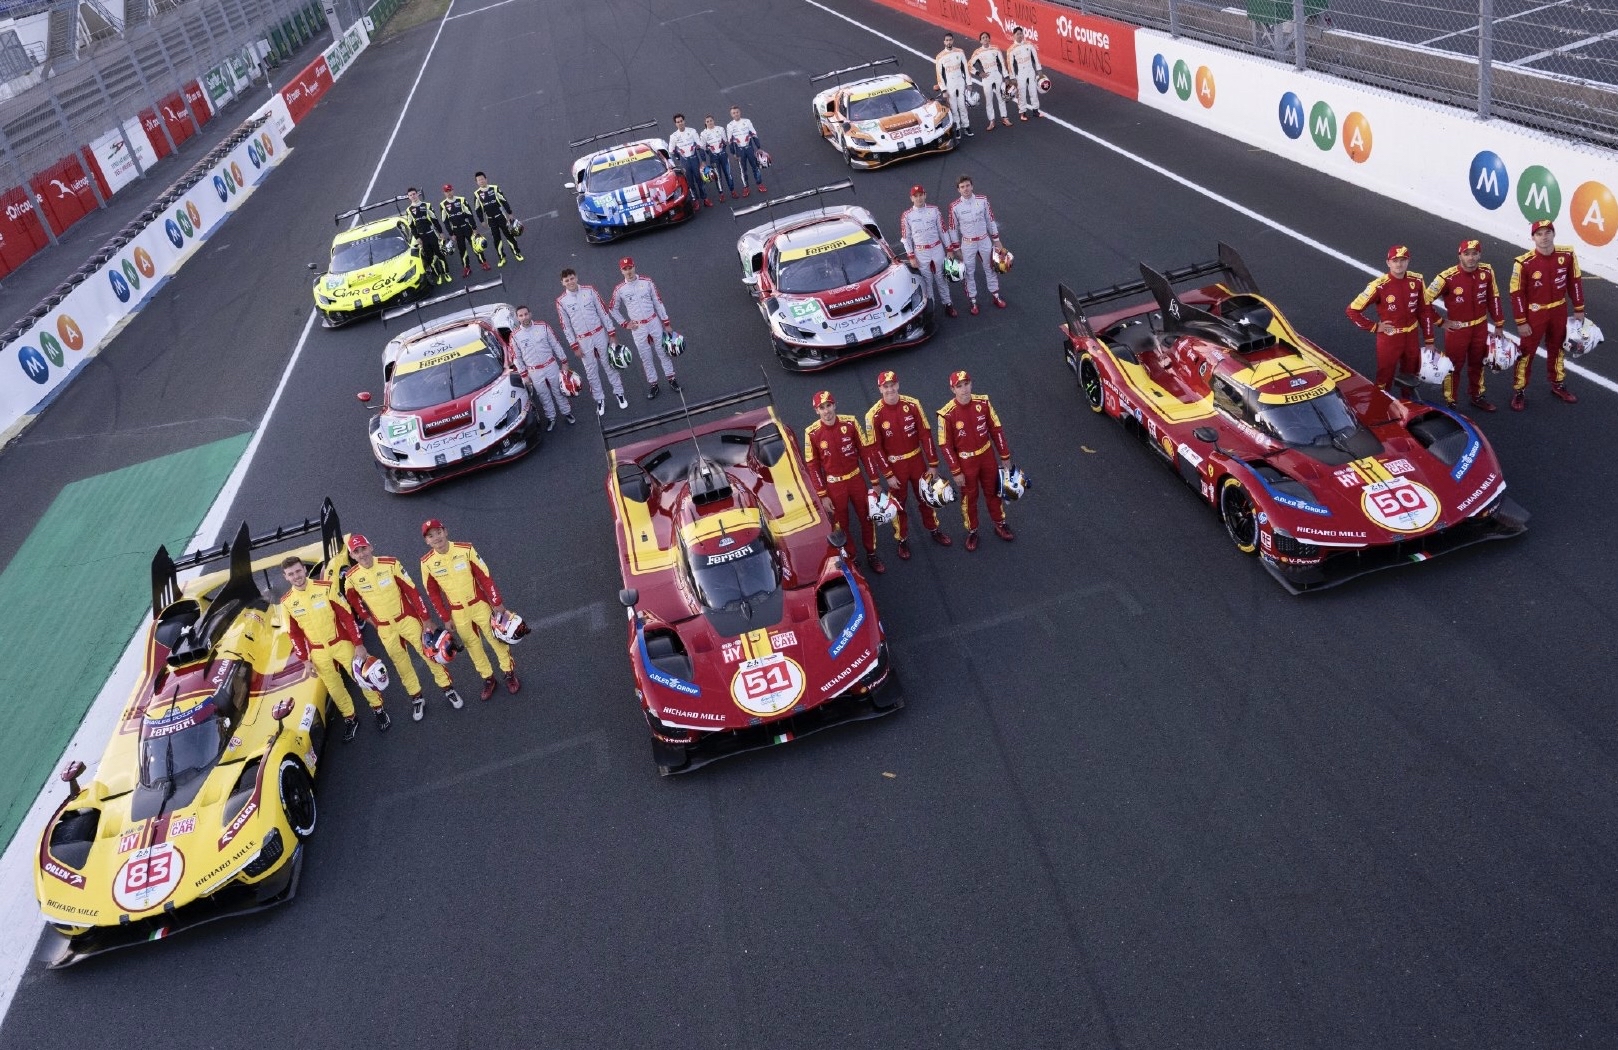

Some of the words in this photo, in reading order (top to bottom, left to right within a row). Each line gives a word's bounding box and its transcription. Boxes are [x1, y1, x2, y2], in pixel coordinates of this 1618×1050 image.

[1074, 26, 1110, 50] course
[1061, 38, 1075, 64] LE
[1078, 44, 1112, 75] MANS
[805, 240, 847, 256] Ferrari
[793, 302, 817, 316] 54
[828, 299, 855, 310] RICHARD
[854, 294, 872, 304] MILLE
[419, 350, 461, 369] Ferrari
[1283, 384, 1329, 404] Ferrari
[425, 418, 451, 429] RICHARD
[451, 410, 469, 421] MILLE
[392, 423, 414, 437] 21
[1389, 463, 1413, 474] CAR
[1376, 488, 1420, 514] 50
[1456, 488, 1484, 512] RICHARD
[1480, 472, 1497, 493] MILLE
[1273, 495, 1297, 508] ADLER
[1304, 505, 1329, 515] GROUP
[1297, 526, 1337, 537] RICHARD
[1338, 530, 1367, 538] MILLE
[706, 544, 755, 566] Ferrari
[773, 637, 796, 649] CAR
[833, 636, 849, 656] ADLER
[722, 646, 741, 664] HY
[744, 666, 790, 695] 51
[820, 667, 852, 693] RICHARD
[851, 648, 872, 669] MILLE
[649, 673, 669, 686] ADLER
[676, 684, 699, 694] GROUP
[662, 706, 699, 719] RICHARD
[700, 712, 726, 721] MILLE
[149, 716, 196, 738] Ferrari
[232, 802, 257, 831] ORLEN
[171, 824, 194, 836] CAR
[118, 833, 139, 853] HY
[44, 863, 71, 880] ORLEN
[127, 856, 170, 888] 83
[195, 861, 231, 888] RICHARD
[232, 840, 257, 862] MILLE
[46, 899, 77, 914] RICHARD
[77, 908, 100, 917] MILLE
